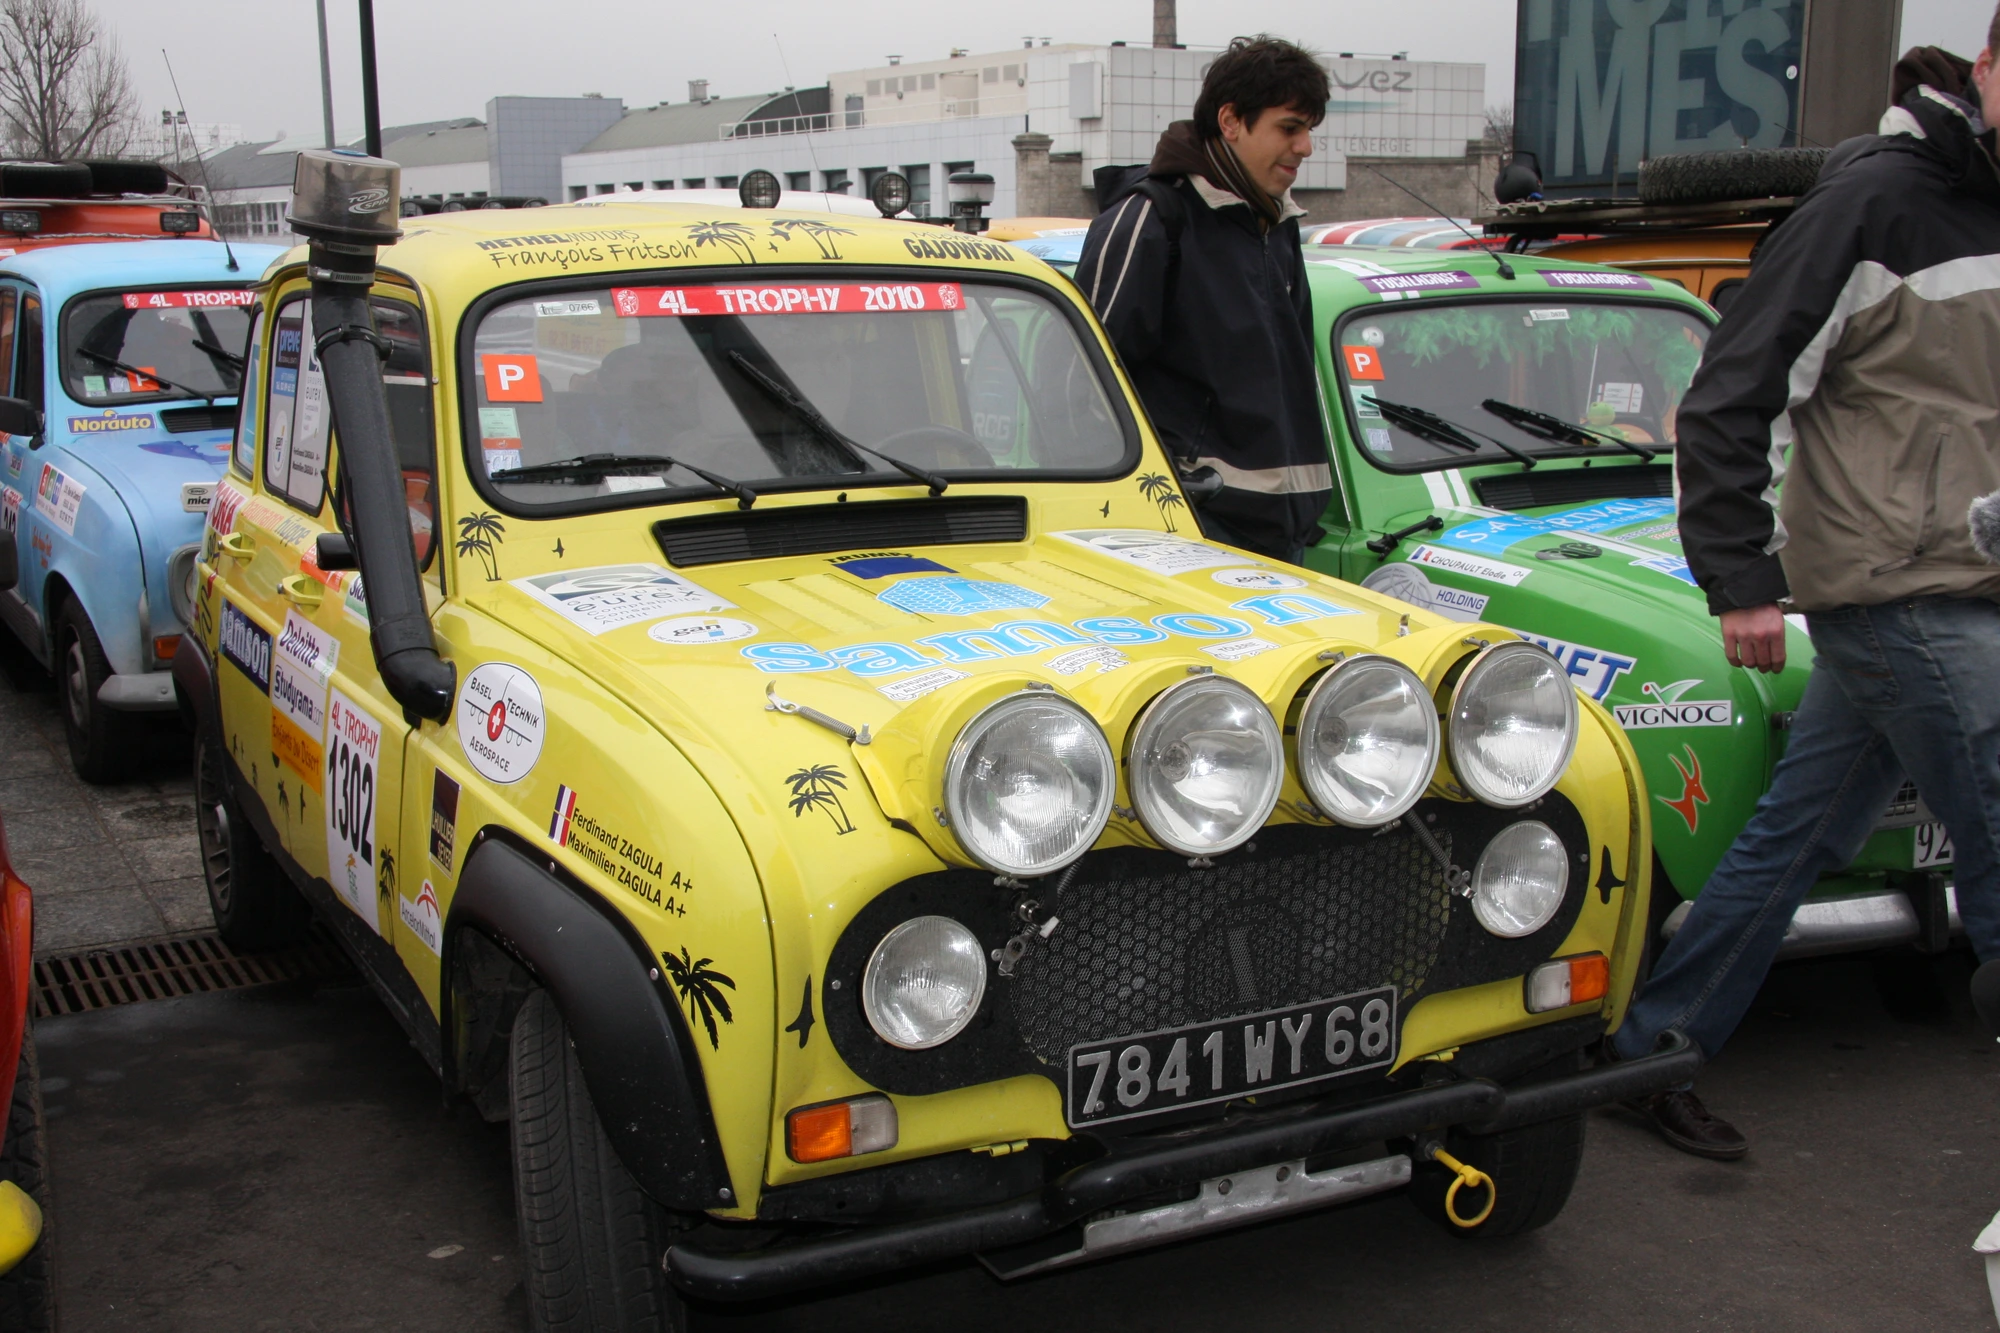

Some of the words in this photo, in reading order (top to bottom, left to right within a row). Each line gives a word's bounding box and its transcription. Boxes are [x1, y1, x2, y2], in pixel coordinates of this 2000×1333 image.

[348, 193, 376, 204] TOP
[365, 197, 390, 209] SPIN
[489, 241, 604, 270] François
[608, 239, 698, 263] Fritsch
[903, 238, 1015, 262] GAJOWSKI
[149, 294, 173, 307] 4L
[183, 292, 255, 306] TROPHY
[658, 290, 700, 314] 4L
[716, 288, 840, 312] TROPHY
[860, 286, 926, 310] 2010
[1353, 353, 1371, 373] P
[498, 364, 525, 391] P
[72, 416, 152, 433] Norauto
[187, 496, 211, 505] micr
[1431, 556, 1482, 573] CHOUPAULT
[1481, 567, 1507, 580] Elodie
[573, 590, 704, 612] eurex
[1436, 589, 1485, 610] HOLDING
[594, 604, 663, 621] Conseil
[602, 613, 650, 625] Audit
[673, 624, 722, 637] gan
[740, 593, 1365, 678] samson
[220, 607, 269, 685] samson
[470, 677, 492, 700] BASEL
[506, 697, 540, 729] TECHNIK
[1616, 705, 1728, 726] VIGNOC
[331, 701, 341, 731] 4L
[344, 709, 379, 760] TROPHY
[469, 736, 511, 773] AEROSPACE
[329, 734, 374, 867] 1302
[572, 807, 620, 851] Ferdinand
[619, 839, 663, 879] ZAGULA
[670, 871, 693, 893] A+
[1917, 822, 1951, 863] 92
[567, 830, 616, 877] Maximilien
[618, 866, 661, 907] ZAGULA
[665, 896, 687, 918] A+
[401, 902, 436, 950] ArcelorMittal
[1077, 1031, 1223, 1115] 7841
[1244, 1013, 1313, 1084] WY
[1325, 998, 1390, 1066] 68
